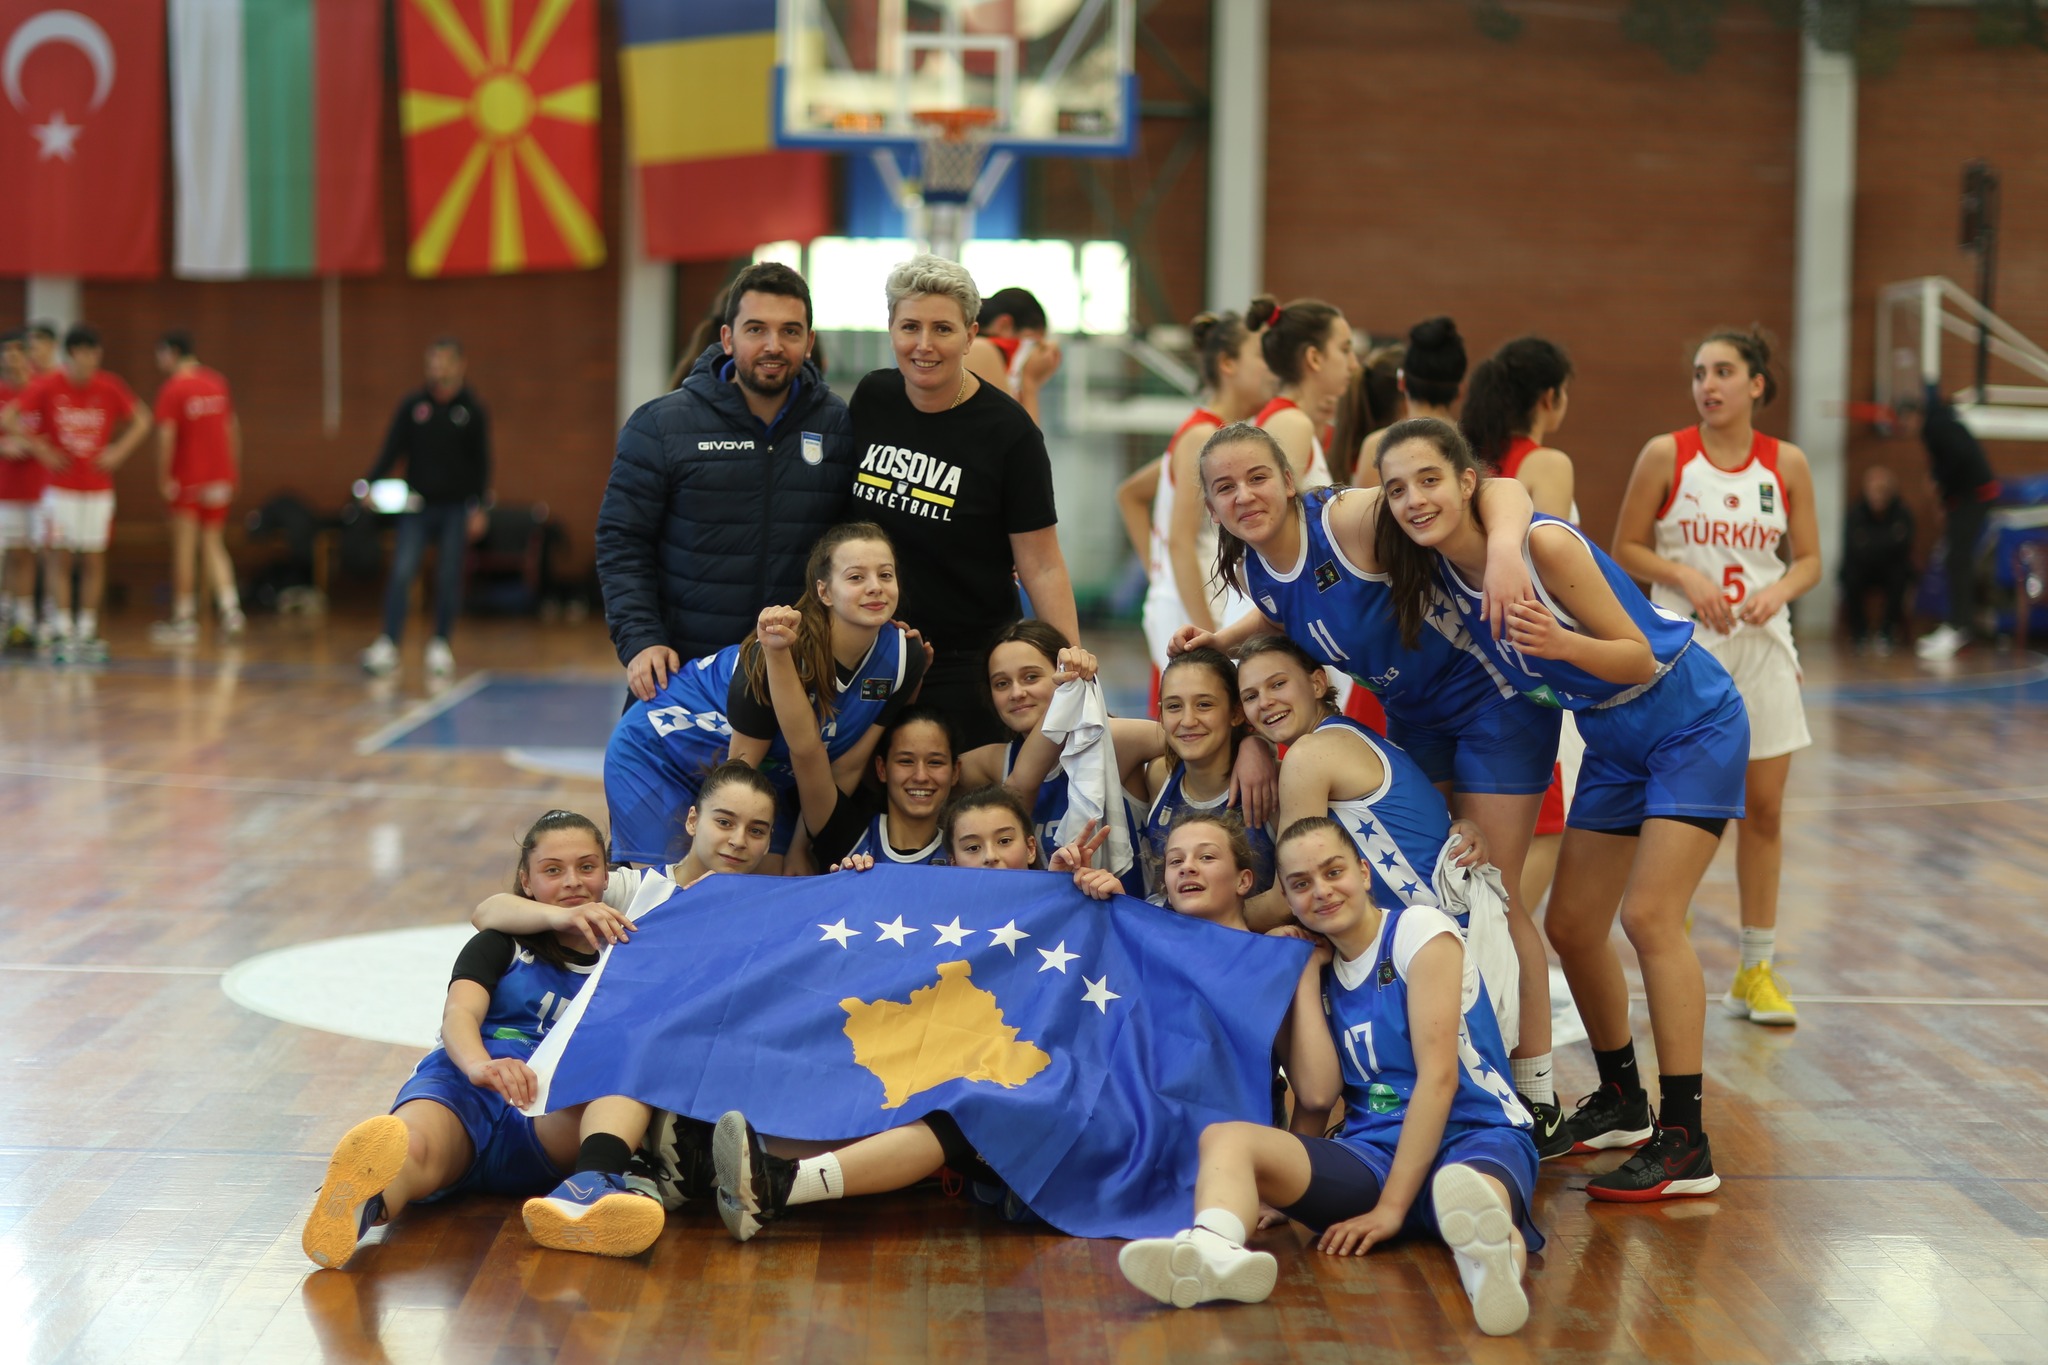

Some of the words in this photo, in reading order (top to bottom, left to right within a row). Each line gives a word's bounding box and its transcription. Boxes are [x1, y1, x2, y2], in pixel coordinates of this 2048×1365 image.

[697, 441, 755, 450] GIVOVA
[860, 443, 962, 496] KOSOVA
[1722, 565, 1746, 606] 5
[1307, 619, 1350, 662] 11
[1343, 1021, 1383, 1083] 17
